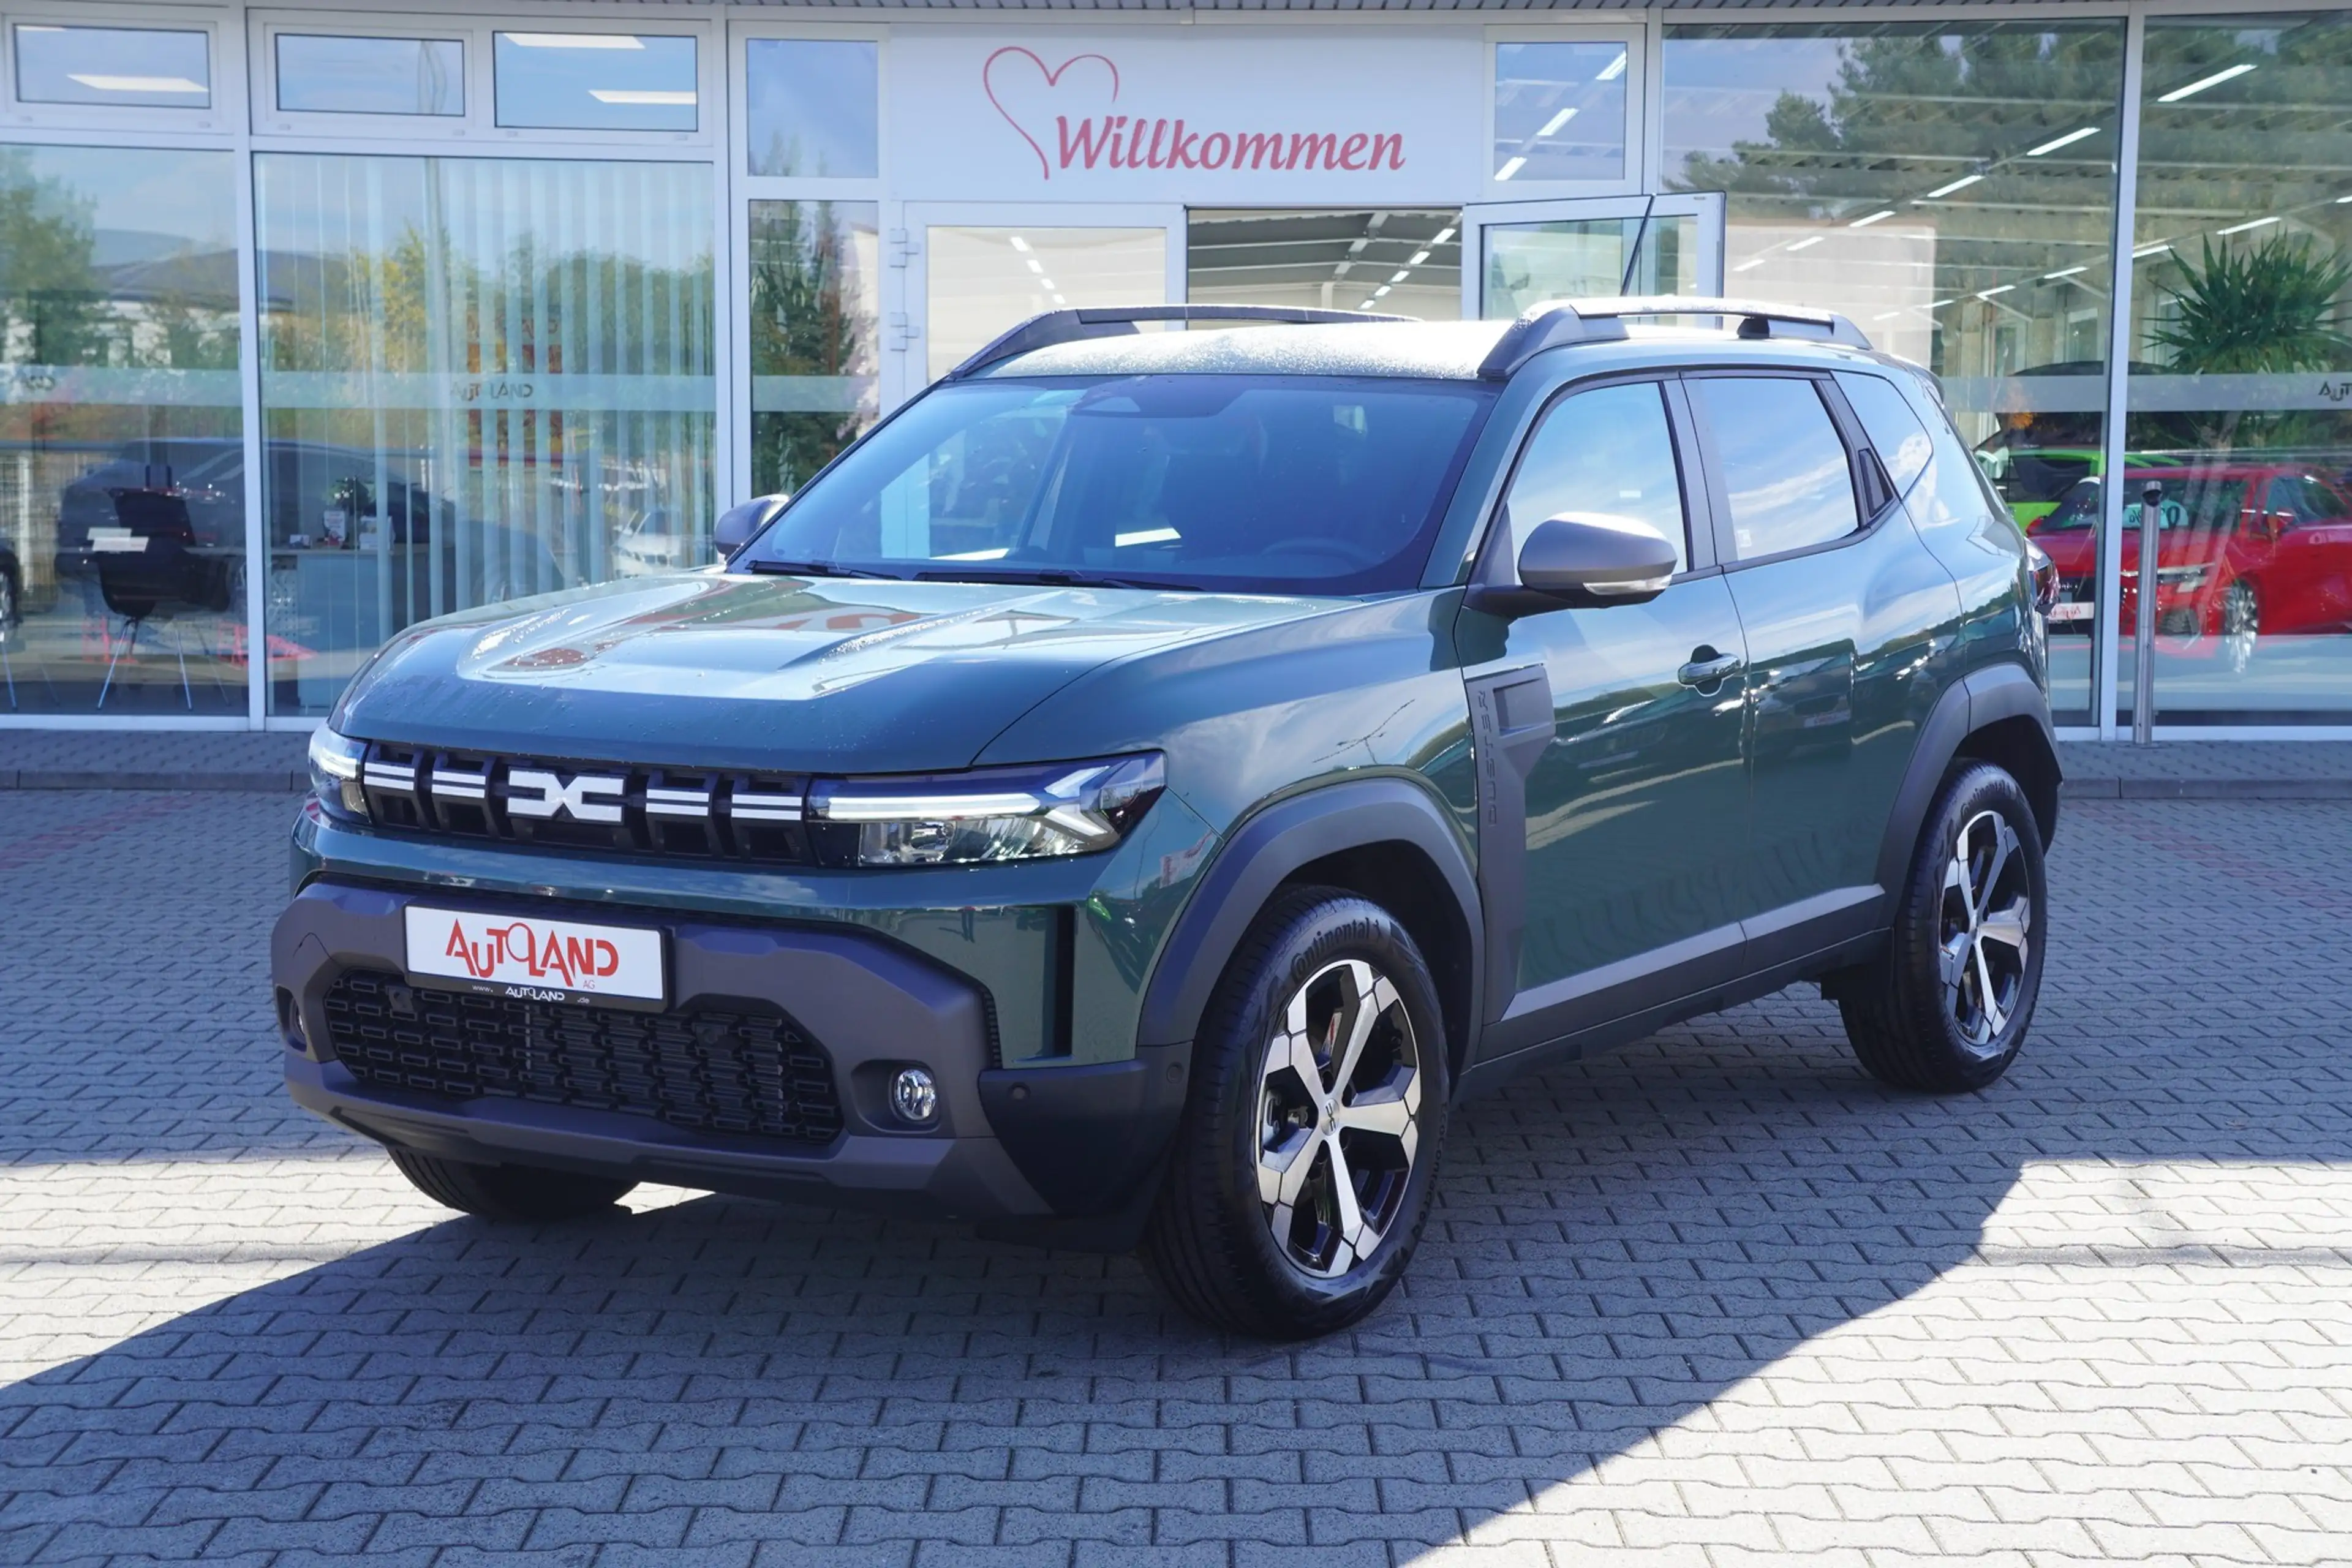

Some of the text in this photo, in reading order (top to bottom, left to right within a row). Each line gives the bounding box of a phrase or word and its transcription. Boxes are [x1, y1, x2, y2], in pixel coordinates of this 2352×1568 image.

[1056, 115, 1406, 171] Willkommen
[451, 381, 534, 402] AUTLAND
[446, 918, 619, 987] AUTOLAND
[1290, 916, 1371, 985] Continental
[582, 979, 595, 990] AG
